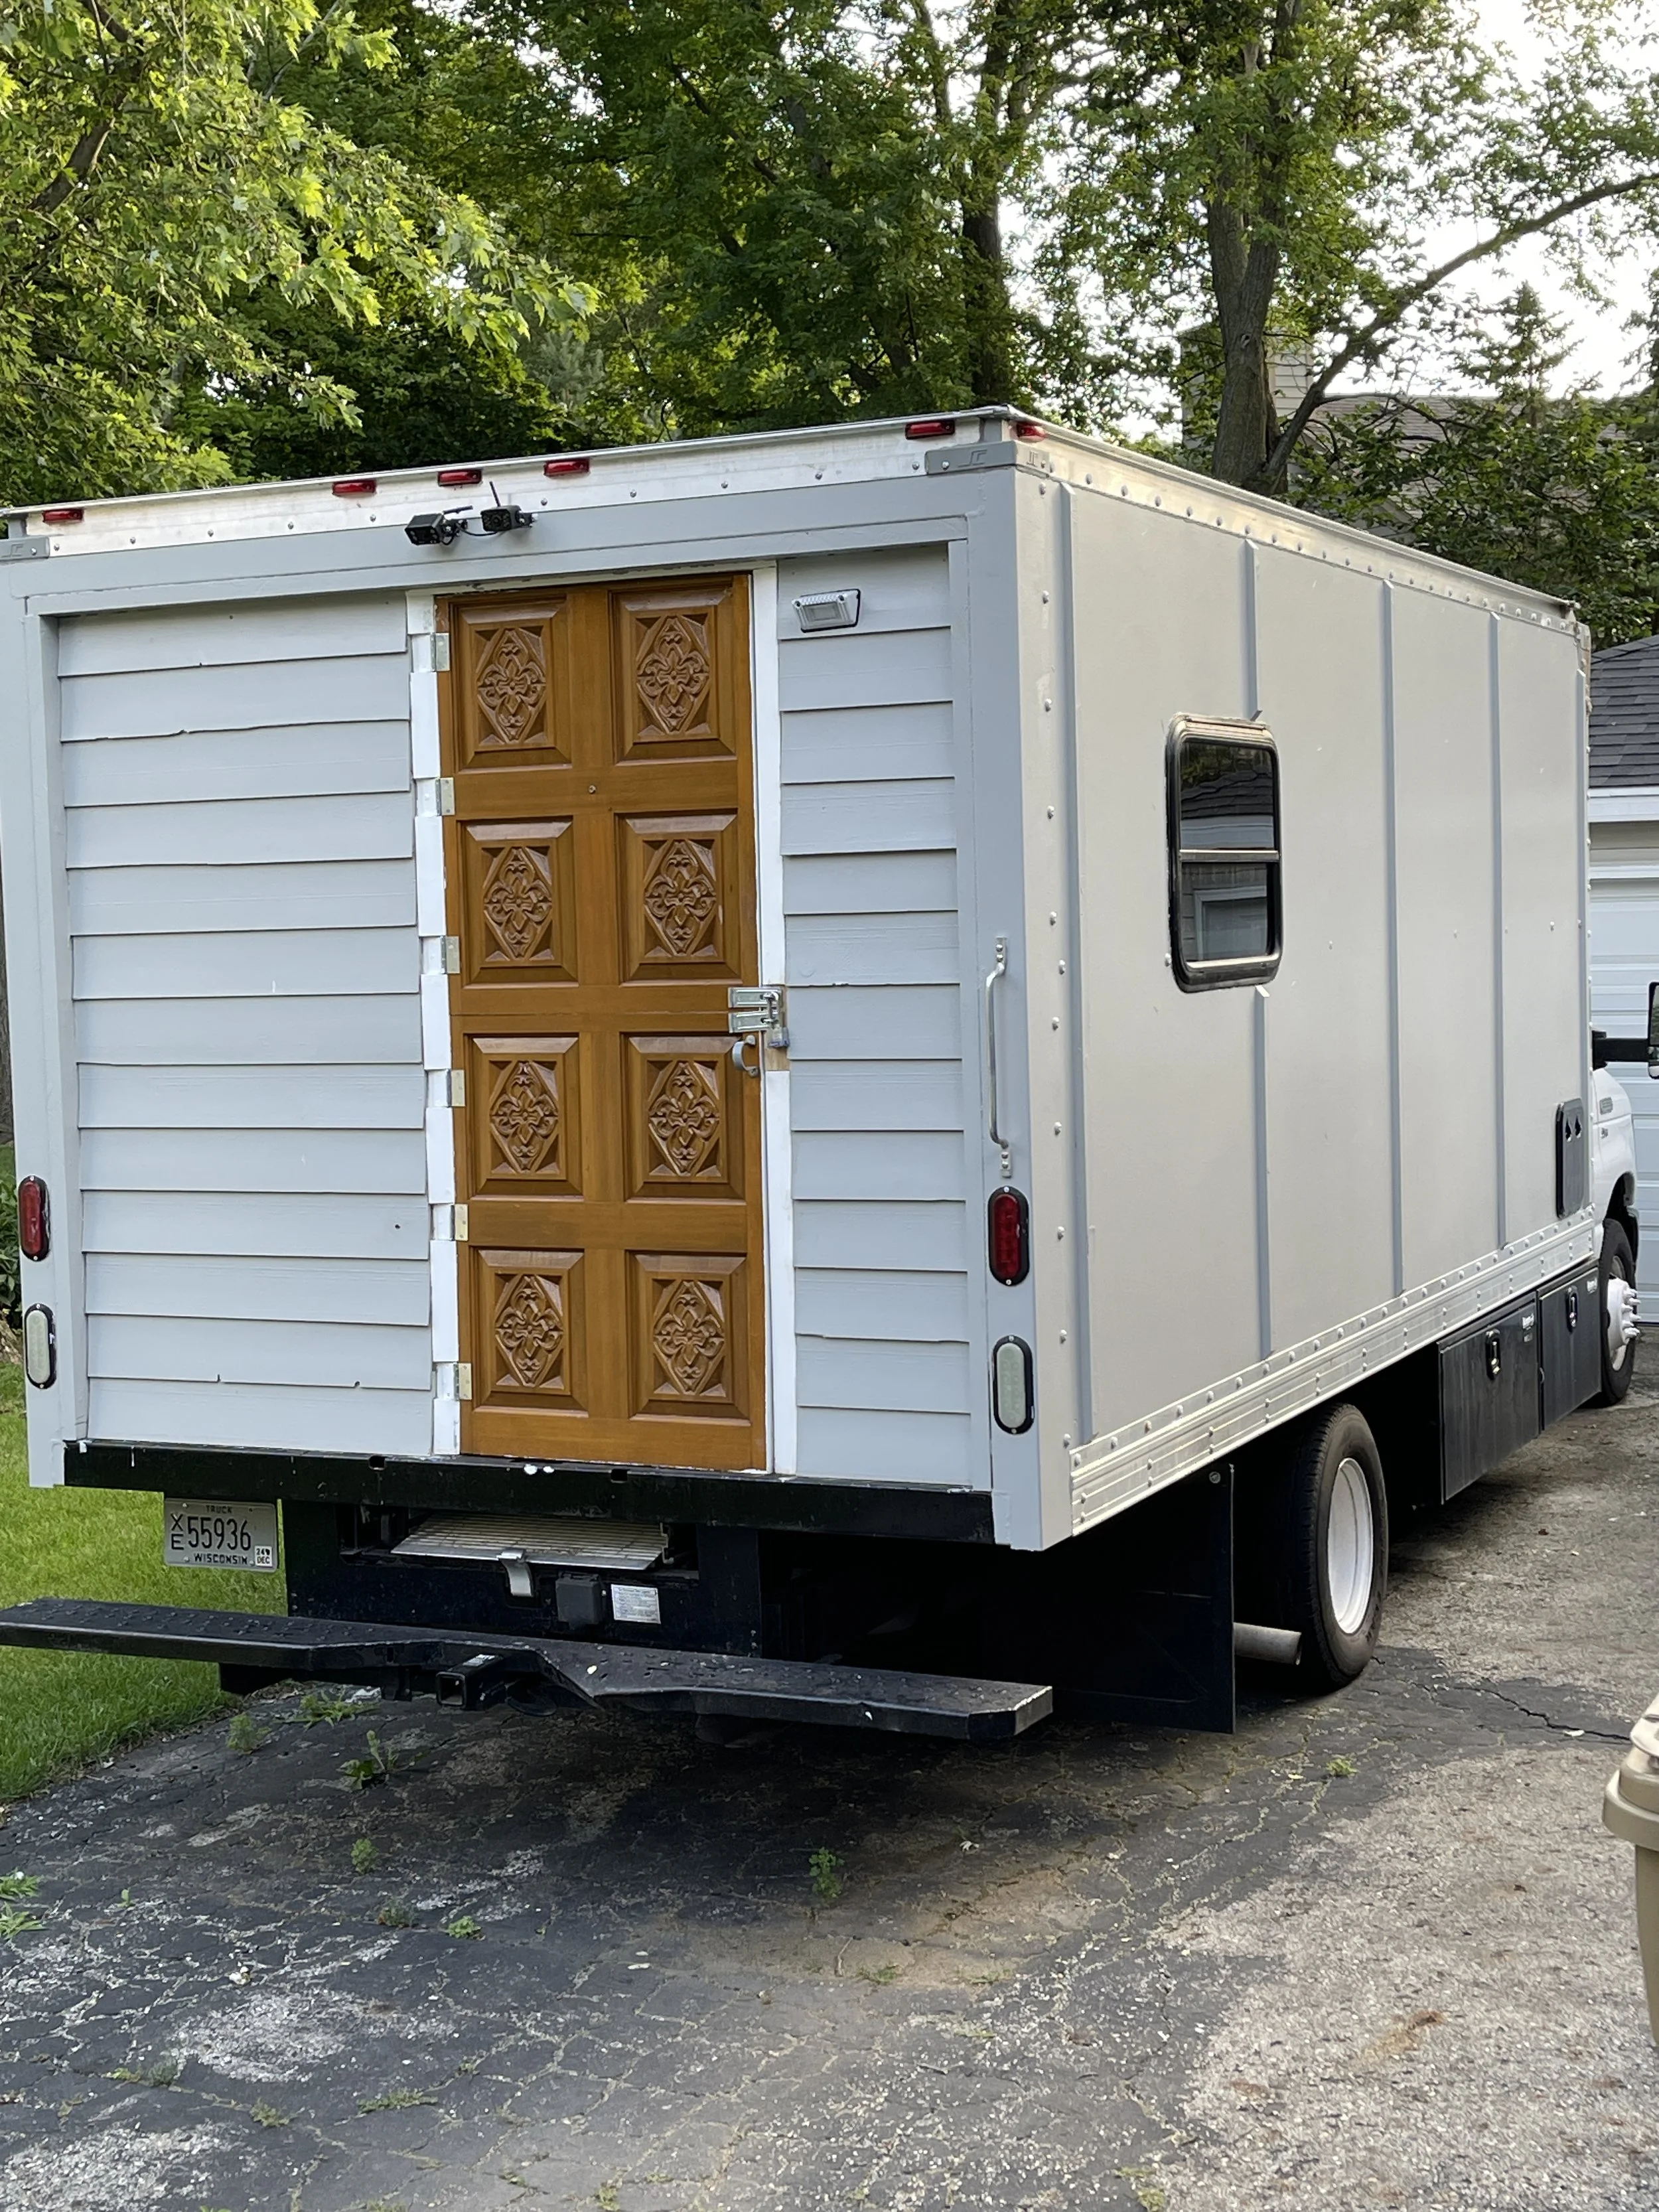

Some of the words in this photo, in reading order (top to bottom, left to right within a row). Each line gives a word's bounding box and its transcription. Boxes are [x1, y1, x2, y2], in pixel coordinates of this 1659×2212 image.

[206, 1505, 232, 1514] TRUCK
[187, 1516, 252, 1551] 55936
[194, 1552, 248, 1566] WISCONSIN
